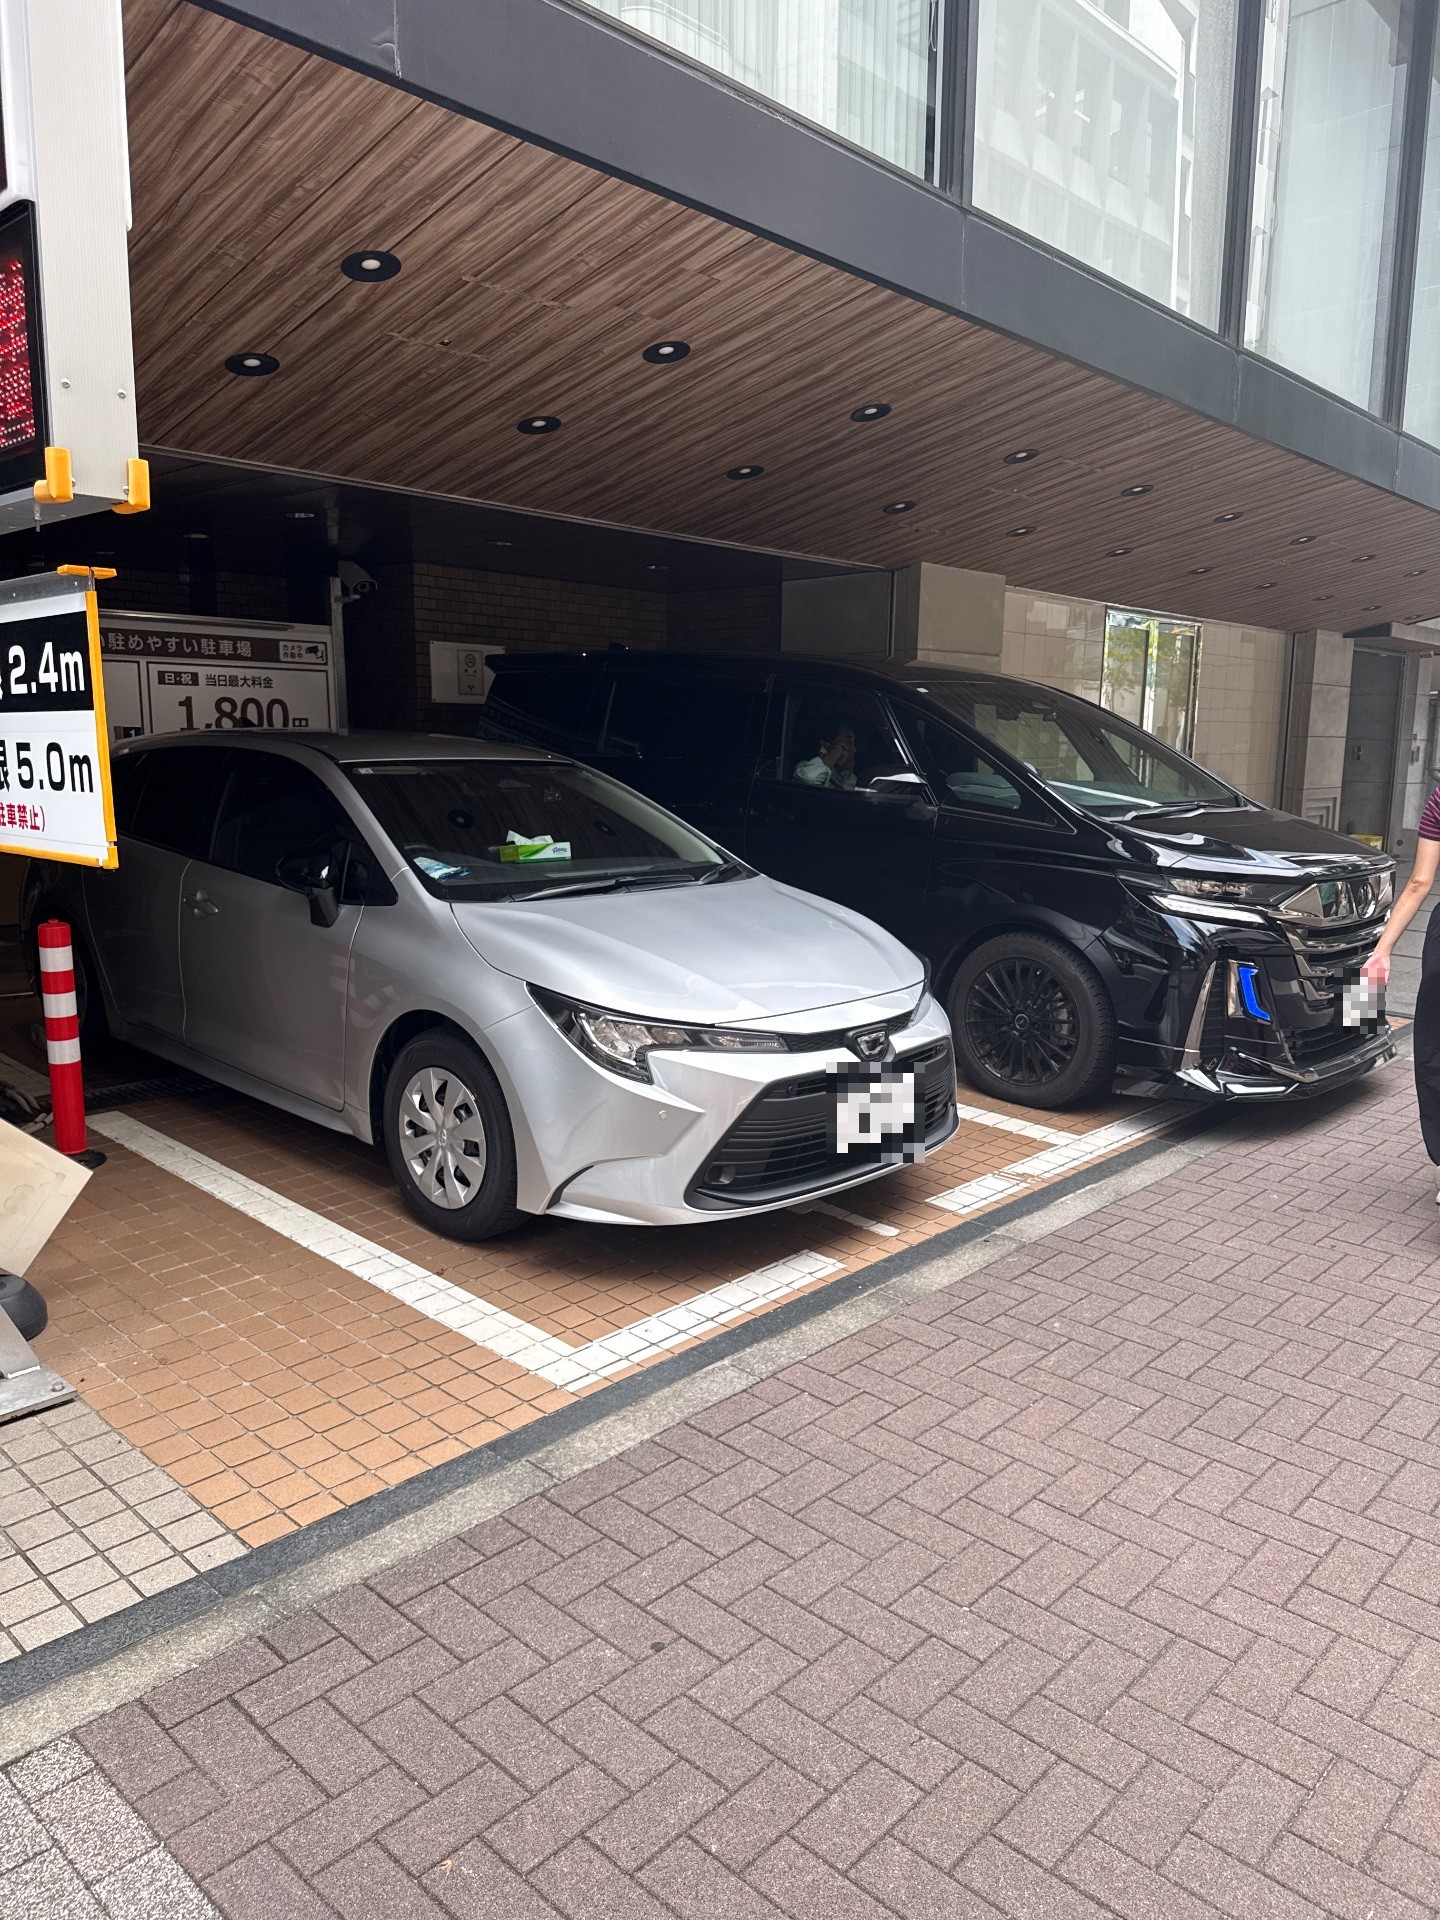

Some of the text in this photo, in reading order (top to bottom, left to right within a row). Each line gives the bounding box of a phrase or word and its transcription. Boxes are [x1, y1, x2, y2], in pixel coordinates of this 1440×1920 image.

[0, 641, 85, 700] 2.4m
[205, 673, 274, 688] 当日最大料金
